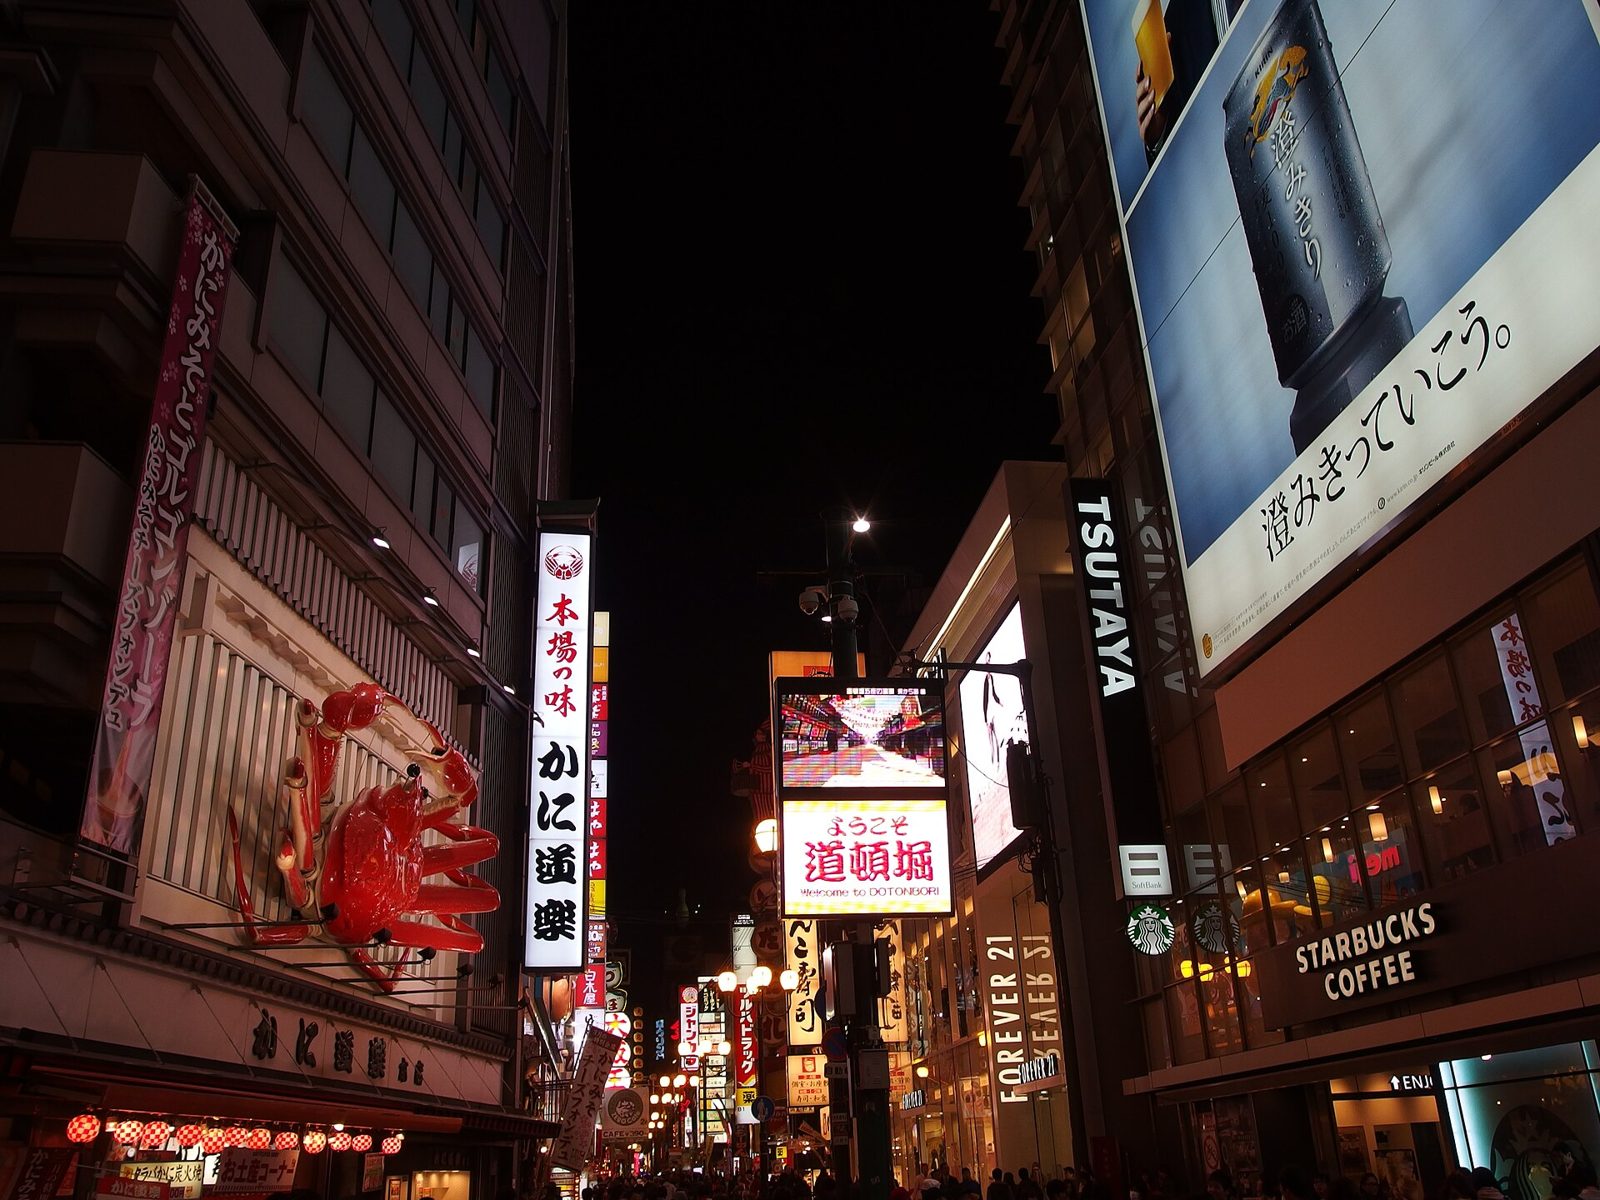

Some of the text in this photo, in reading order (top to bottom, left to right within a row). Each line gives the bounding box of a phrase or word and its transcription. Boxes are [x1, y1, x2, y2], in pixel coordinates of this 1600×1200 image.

[1254, 46, 1273, 79] KIRIN
[1271, 110, 1321, 281] 澄みきり
[1260, 300, 1511, 562] 澄みきっていこう。
[1077, 496, 1136, 697] TSUTAYA
[543, 592, 579, 718] 本場の味
[827, 816, 909, 837] ようこそ
[804, 840, 934, 883] 道頓堀
[1131, 880, 1163, 890] SoftBank
[800, 887, 940, 898] Welcome to DOTONBORI
[1296, 902, 1436, 974] STARBUCKS
[582, 968, 598, 1005] 白木屋
[1324, 950, 1415, 1001] COFFEE
[738, 986, 754, 1074] ツルハドラッグ
[986, 935, 1029, 1104] FOREVER 21
[220, 1158, 295, 1183] お土産コーナー
